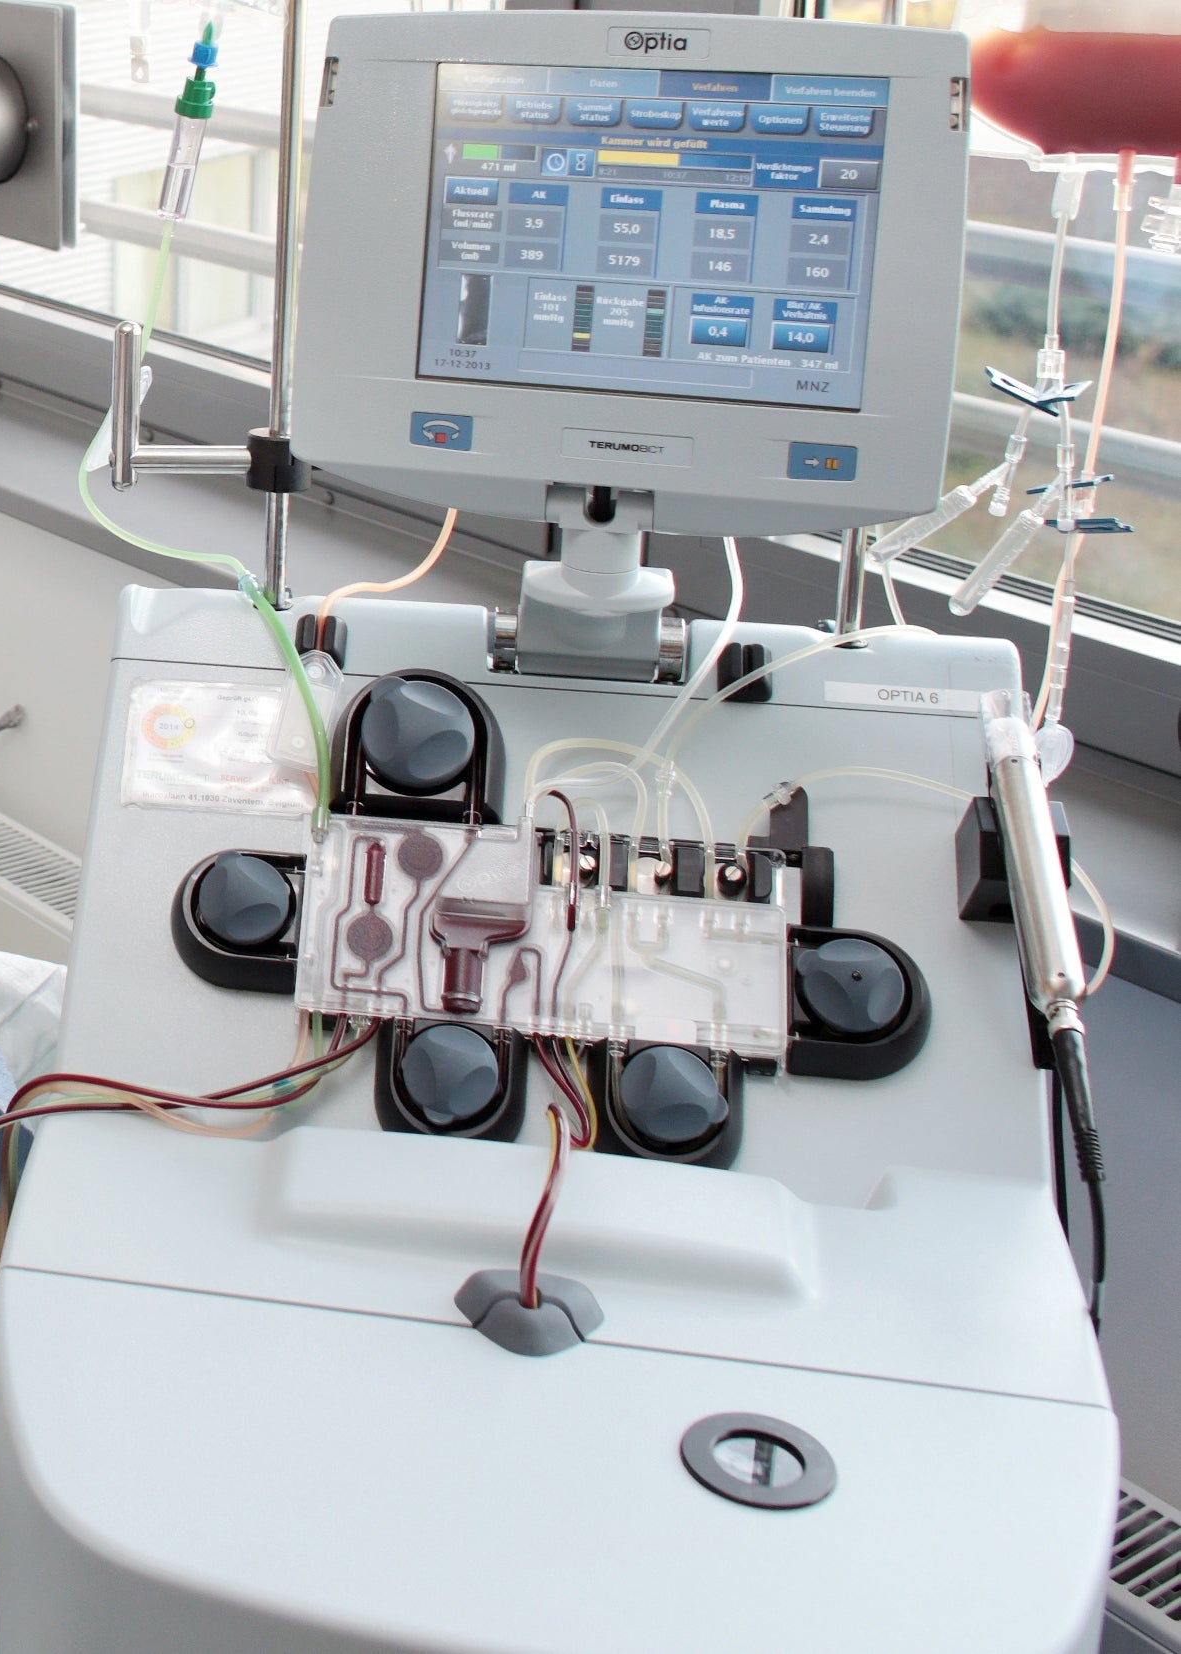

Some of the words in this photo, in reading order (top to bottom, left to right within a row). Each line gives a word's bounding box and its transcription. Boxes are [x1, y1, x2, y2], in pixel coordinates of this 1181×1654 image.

[624, 31, 688, 54] Optia
[589, 78, 618, 89] Daten
[692, 82, 739, 93] Verfahren
[785, 86, 832, 97] Verfahren
[834, 88, 876, 98] beenden
[521, 111, 550, 120] status
[580, 113, 610, 122] status
[630, 109, 682, 121] Stroboskop
[758, 115, 804, 126] Optionen
[820, 112, 870, 123] Erweiterte
[819, 123, 870, 134] Steuerung
[601, 136, 644, 147] Kammer
[648, 137, 671, 148] wird
[481, 162, 500, 171] 471
[503, 163, 516, 172] ml
[770, 171, 799, 181] faktor
[840, 168, 858, 180] 20
[453, 186, 489, 196] Aktuell
[531, 190, 547, 199] AK
[610, 194, 644, 205] Einlass
[709, 199, 746, 210] Plasma
[452, 209, 495, 219] Flussrate
[799, 204, 852, 216] Sammlung
[451, 241, 491, 251] Volumen
[460, 251, 480, 261] (ml)
[519, 250, 544, 261] 389
[608, 254, 641, 266] 5179
[708, 260, 732, 272] 146
[805, 266, 830, 278] 160
[534, 291, 567, 302] Einlass
[610, 307, 629, 317] 205
[533, 312, 565, 324] mmHg
[602, 318, 635, 328] mmHg
[449, 348, 477, 358] 10:37
[434, 358, 491, 370] 17-12-2013
[697, 351, 712, 361] AK
[715, 354, 738, 363] zum
[741, 355, 791, 367] Patienten
[802, 359, 822, 369] 347
[824, 360, 839, 370] ml
[796, 380, 830, 393] MNZ
[877, 688, 925, 703] OPTIA
[929, 692, 939, 704] 6
